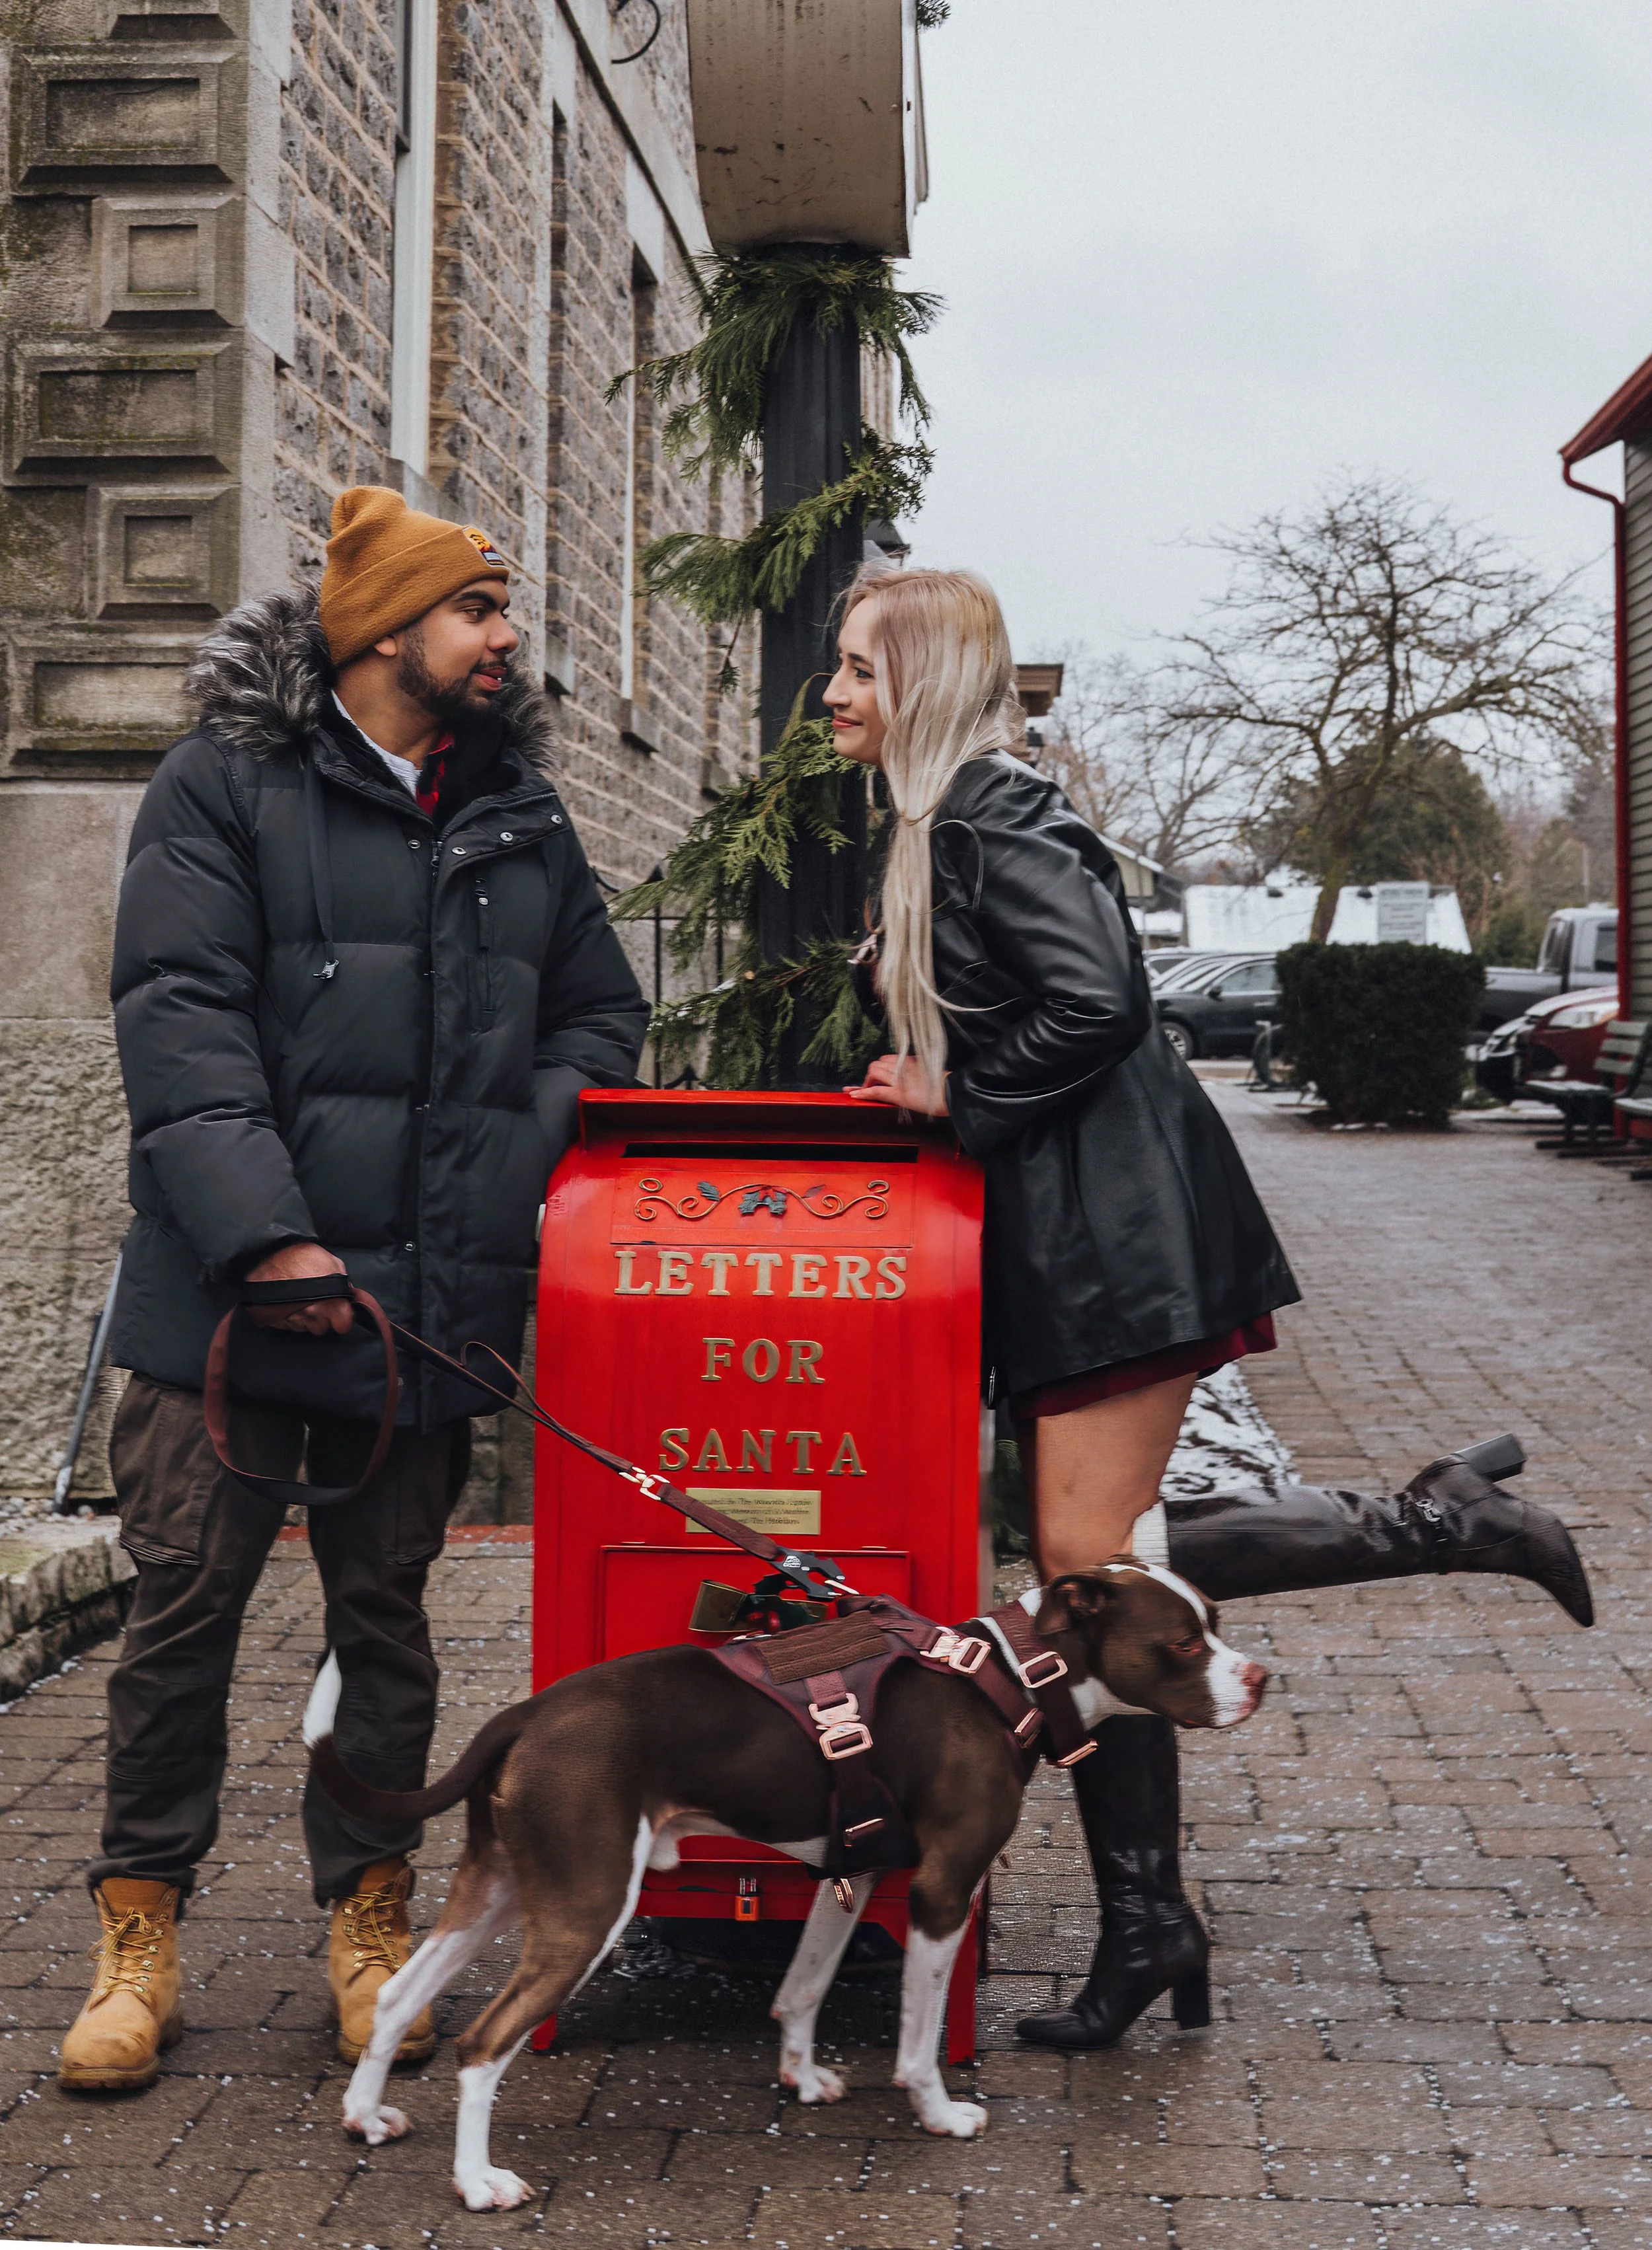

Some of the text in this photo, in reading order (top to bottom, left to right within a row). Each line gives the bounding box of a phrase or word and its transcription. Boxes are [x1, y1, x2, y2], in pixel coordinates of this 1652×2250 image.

[613, 1251, 907, 1300] LETTERS
[700, 1337, 826, 1384] FOR
[658, 1428, 868, 1476] SANTA
